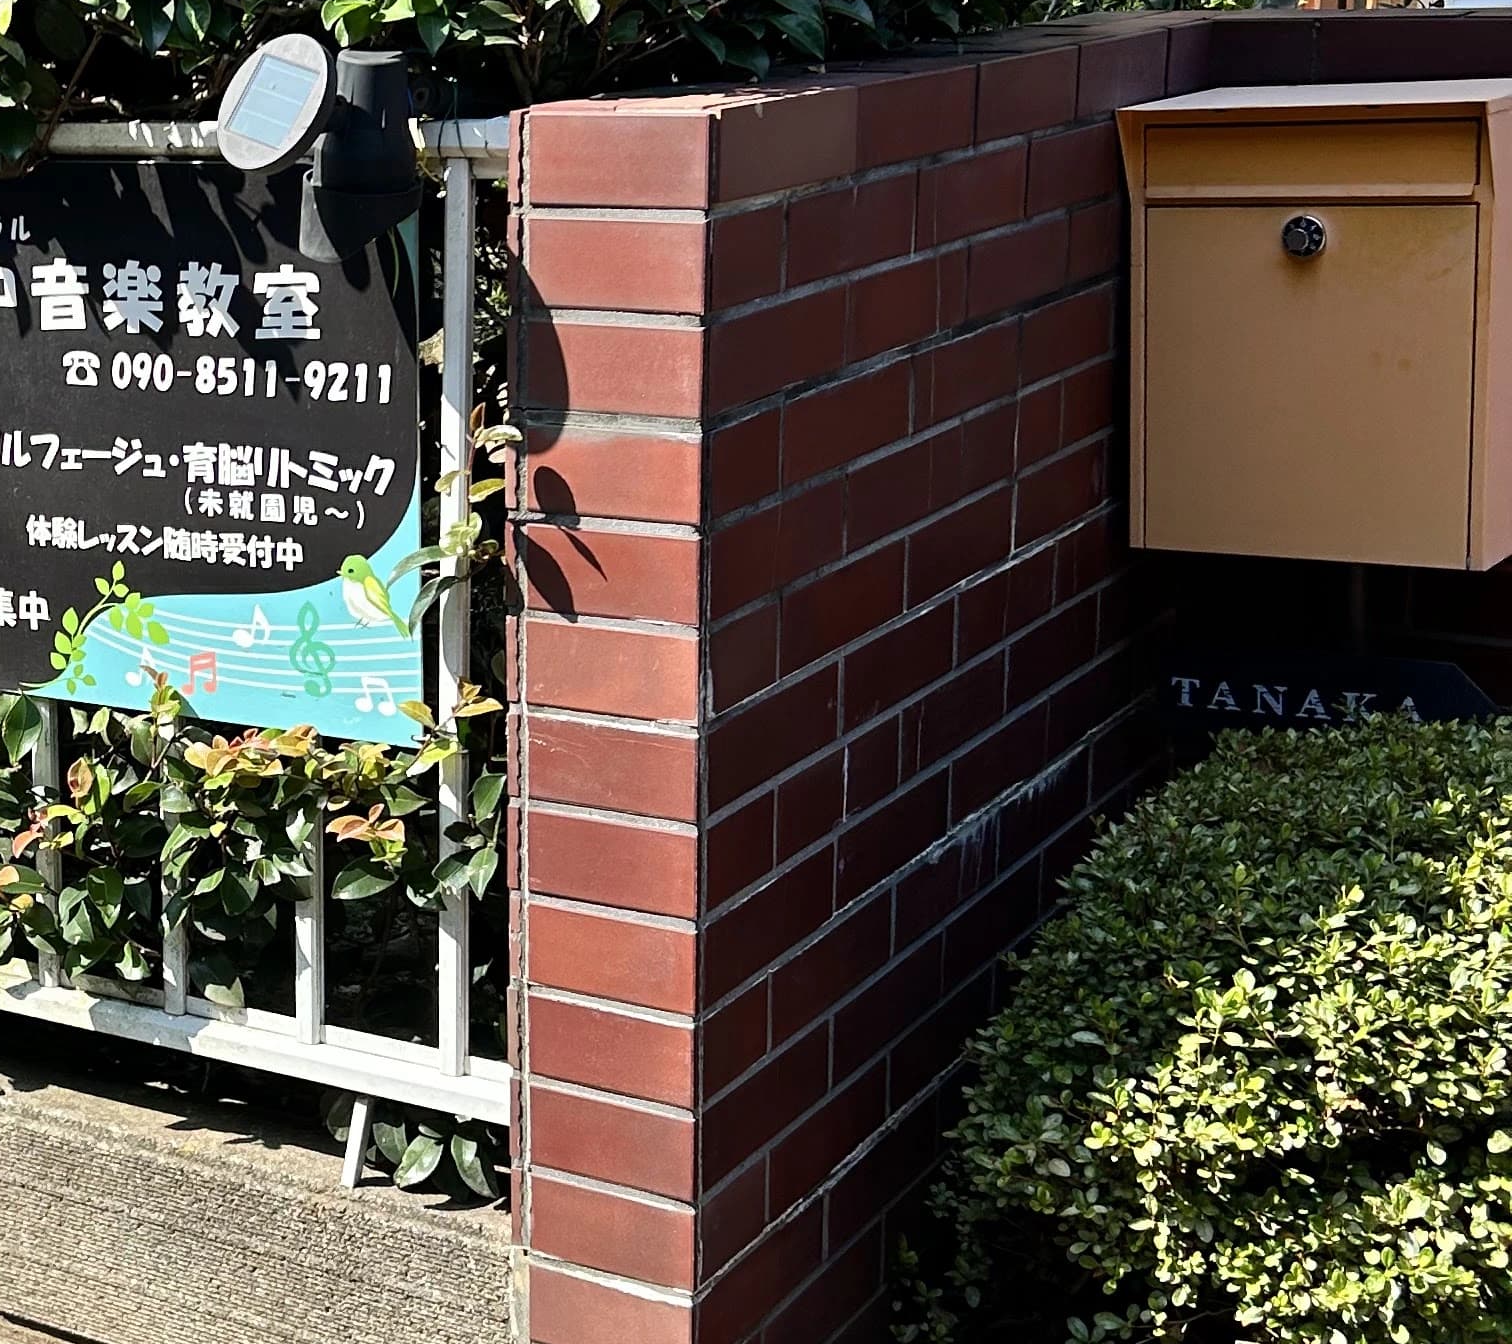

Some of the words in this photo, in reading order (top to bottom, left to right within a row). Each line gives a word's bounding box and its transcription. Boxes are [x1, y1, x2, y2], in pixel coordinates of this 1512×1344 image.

[111, 351, 392, 404] 090-8511-9211
[26, 514, 305, 571] 体験レッスン随時受付中
[1171, 676, 1423, 723] TANAKA
